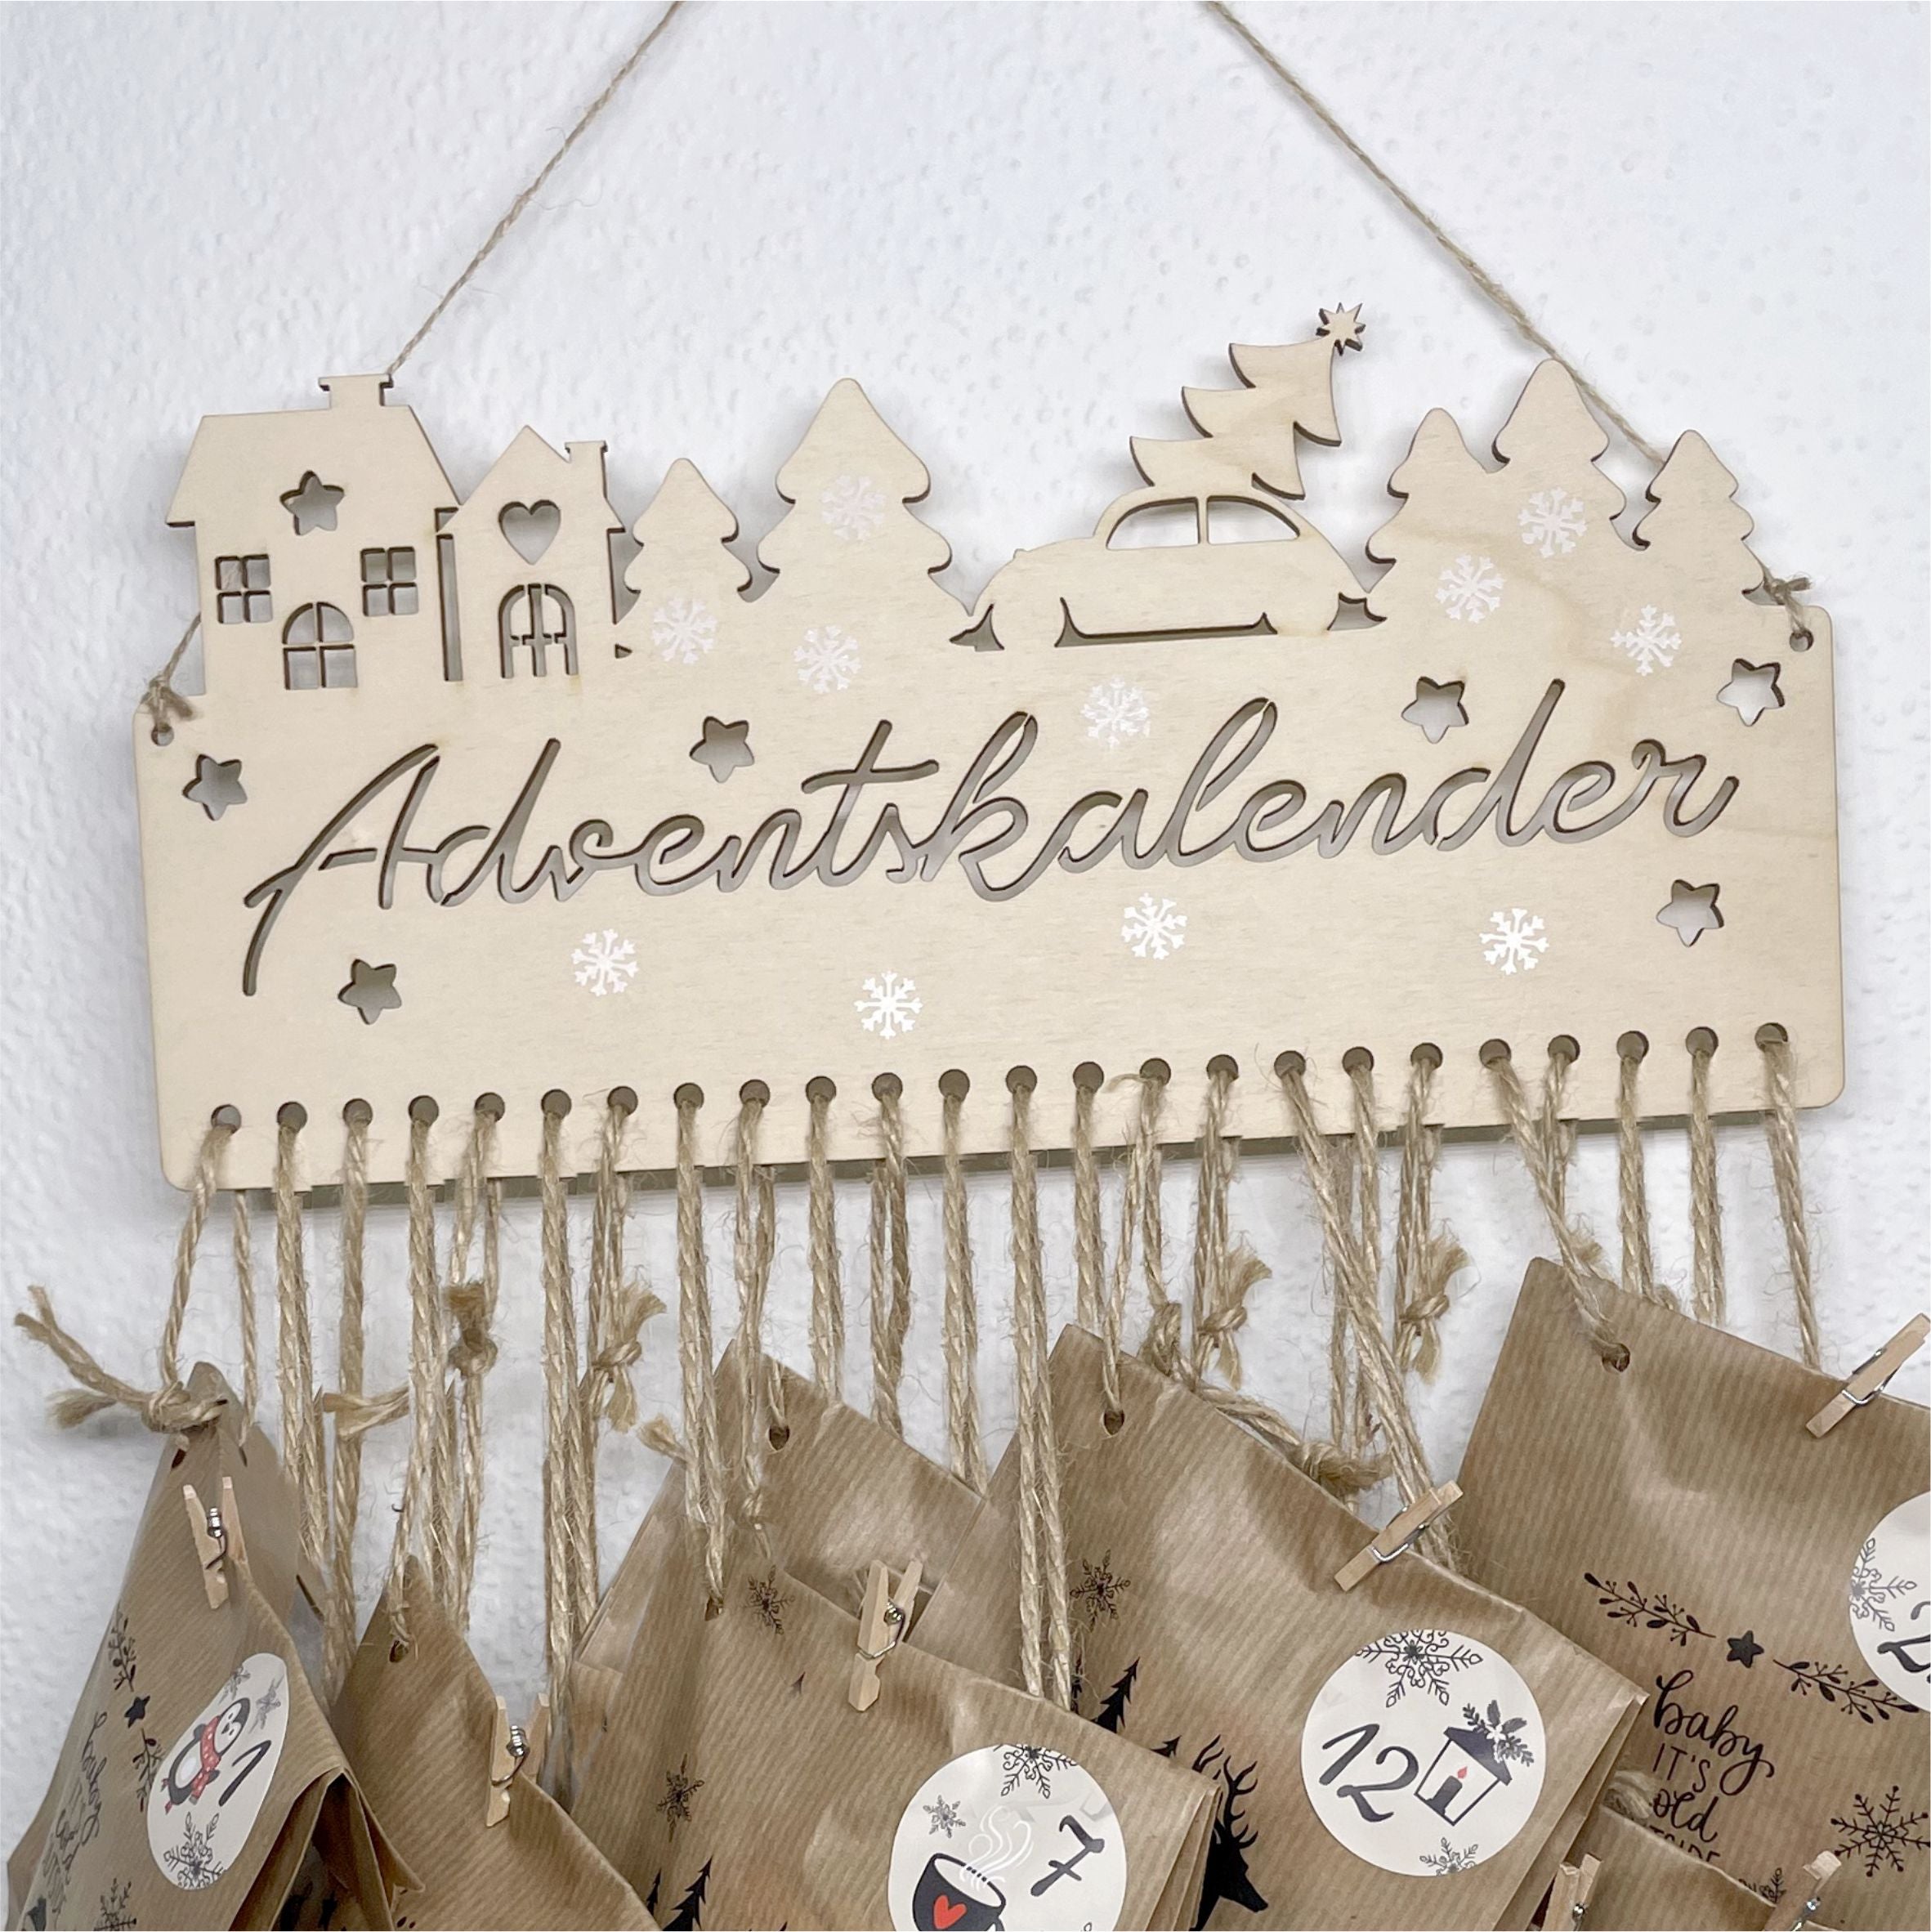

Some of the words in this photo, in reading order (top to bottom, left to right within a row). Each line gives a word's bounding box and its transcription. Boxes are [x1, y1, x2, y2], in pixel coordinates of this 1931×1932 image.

[244, 677, 1739, 997] Adventskalender
[1877, 1601, 1931, 1684] 2
[218, 1740, 272, 1807] 1
[1319, 1723, 1419, 1824] 12
[1652, 1742, 1710, 1793] IT'S
[1653, 1669, 1775, 1796] baby
[1030, 1814, 1105, 1897] 7
[1649, 1788, 1719, 1843] old
